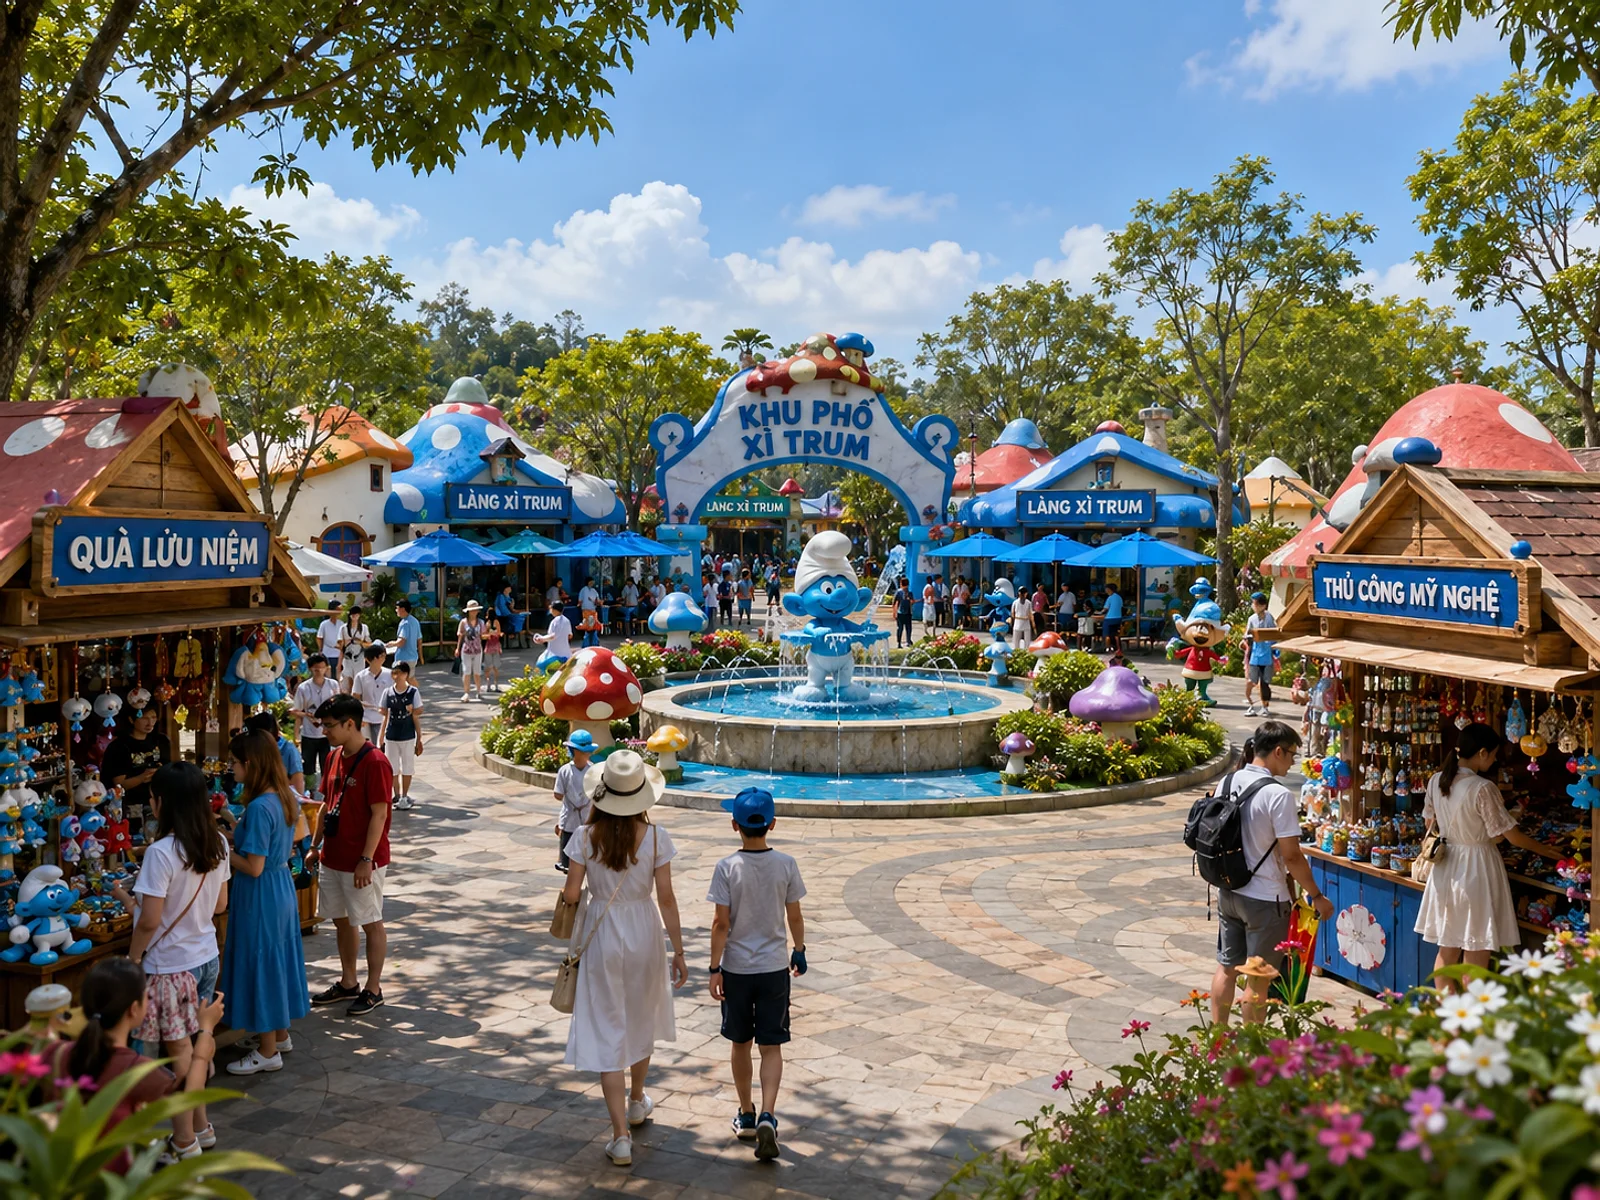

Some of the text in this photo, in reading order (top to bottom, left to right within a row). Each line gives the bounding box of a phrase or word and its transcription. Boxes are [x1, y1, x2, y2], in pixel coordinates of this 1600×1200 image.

[738, 398, 876, 430] KHU PHỐ
[783, 430, 870, 461] TRUM
[458, 488, 562, 511] LÀNG XÌ TRUM
[753, 502, 784, 512] TRUM
[1027, 494, 1143, 515] LÀNG XÌ TRUM
[68, 526, 135, 574] QUÀ
[200, 528, 259, 573] NIỆM
[1323, 570, 1500, 619] THỦ CÔNG MỸ NGHỆ
